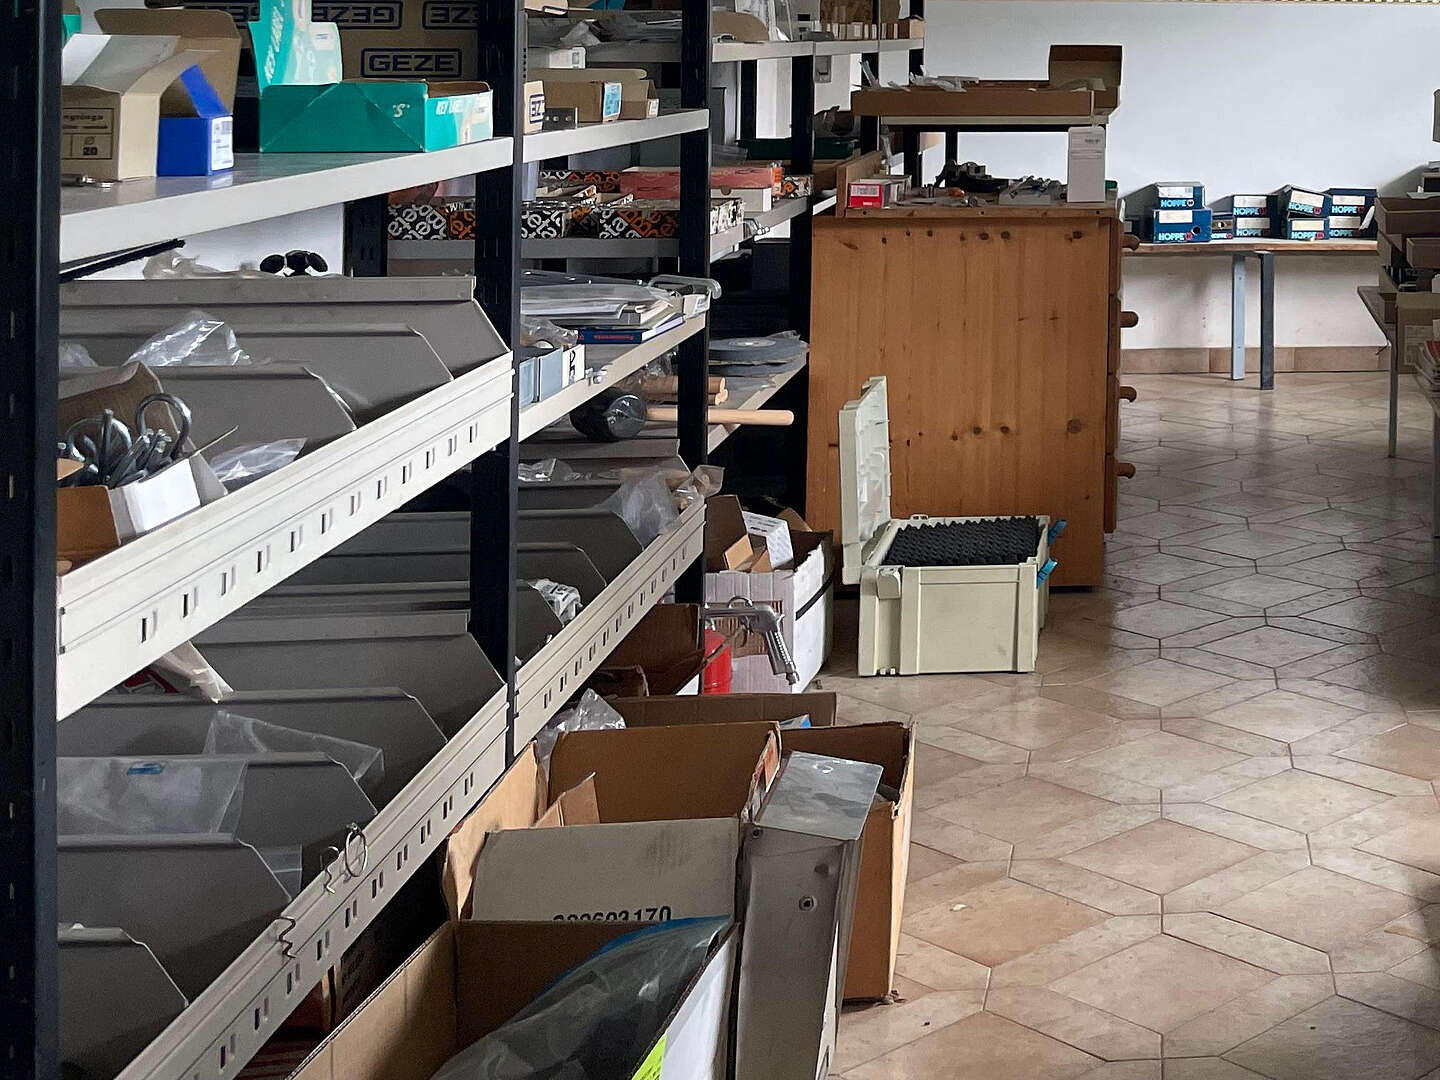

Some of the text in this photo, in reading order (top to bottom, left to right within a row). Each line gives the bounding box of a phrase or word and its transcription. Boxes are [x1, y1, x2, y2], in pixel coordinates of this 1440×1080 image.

[369, 55, 454, 71] GEZE
[1161, 199, 1187, 208] HOPPE
[1289, 202, 1314, 214] HOPPE
[1233, 207, 1260, 215] HOPPE
[1332, 205, 1358, 214] HOPPE
[1159, 232, 1186, 241] HOPPE
[1292, 231, 1317, 239] HOPPE
